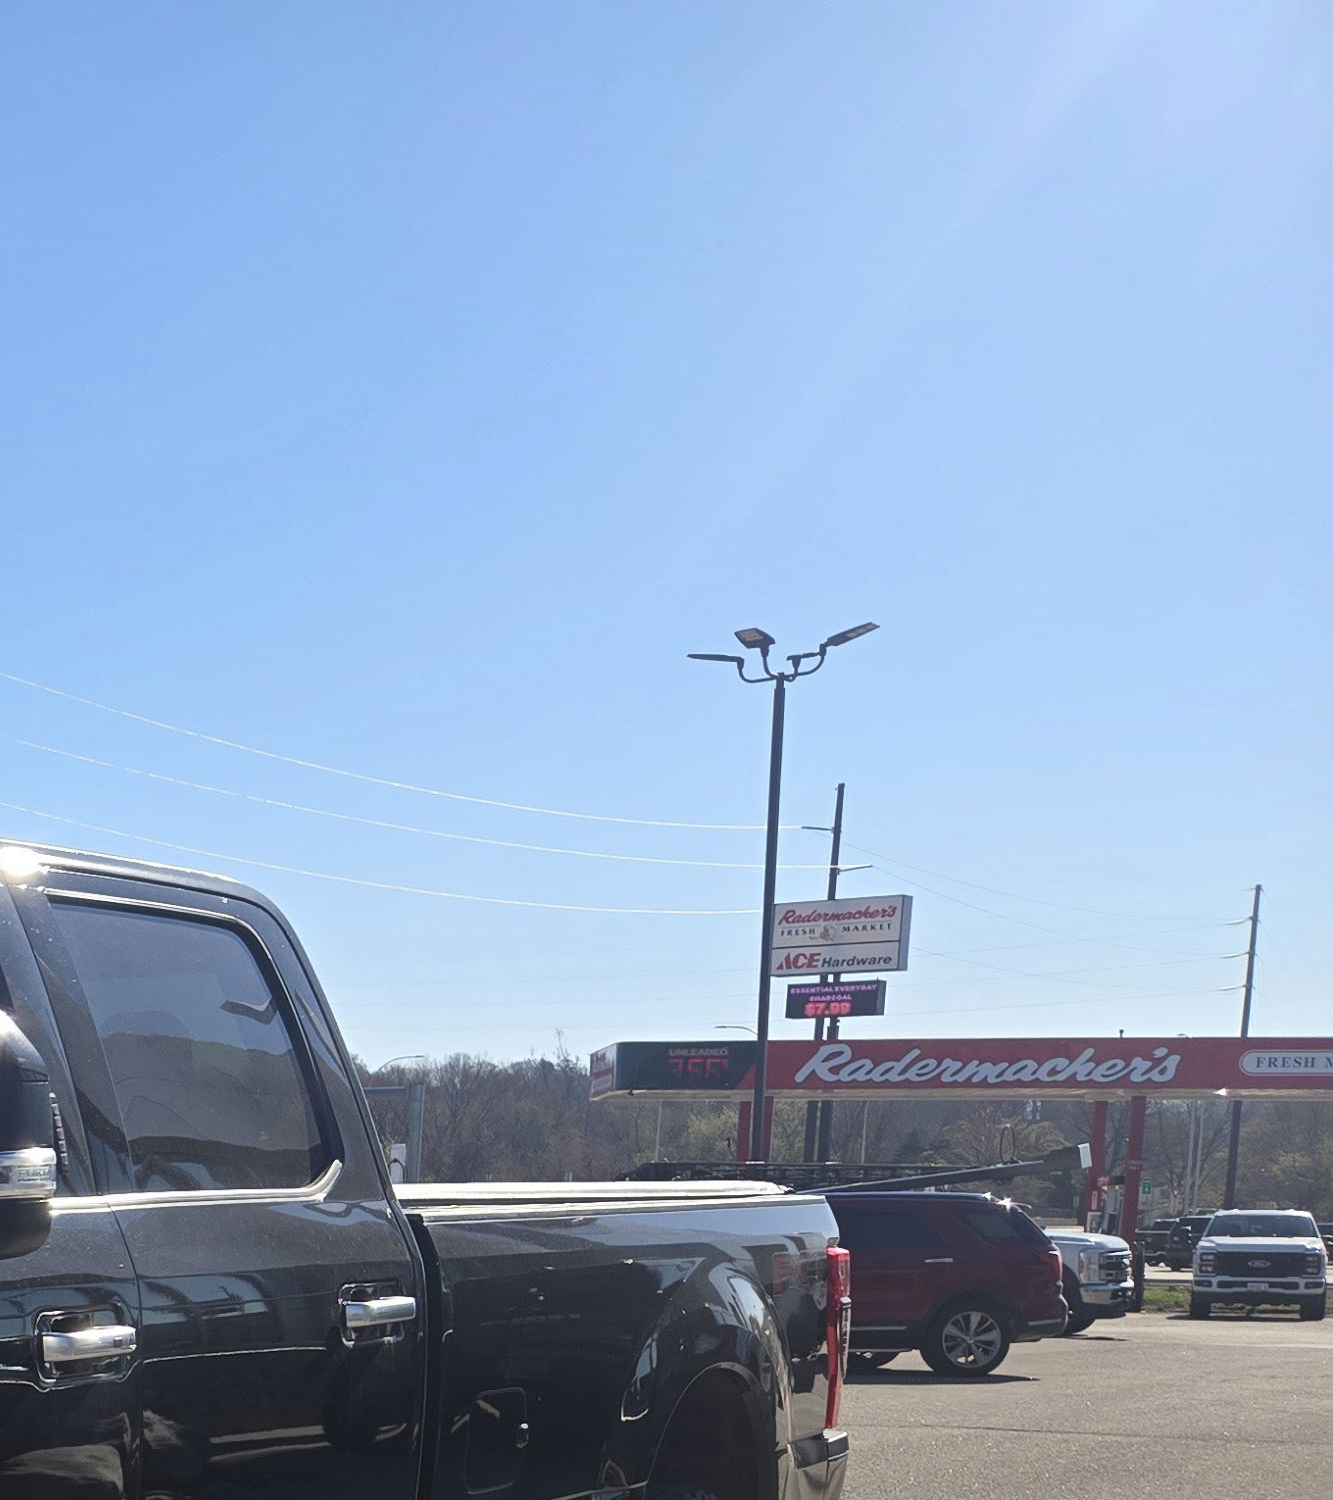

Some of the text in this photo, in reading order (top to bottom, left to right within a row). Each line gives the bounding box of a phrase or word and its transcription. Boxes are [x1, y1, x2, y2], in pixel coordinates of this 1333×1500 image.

[778, 905, 898, 926] Radermacher's
[781, 923, 893, 937] FRESH MARKET
[776, 951, 893, 971] ACE Hardware
[790, 984, 878, 994] ESSENTIAL EVERYDAY
[809, 994, 852, 1002] CHARCOAL
[794, 1043, 1182, 1084] Radermacher's
[1255, 1056, 1316, 1068] FRESH
